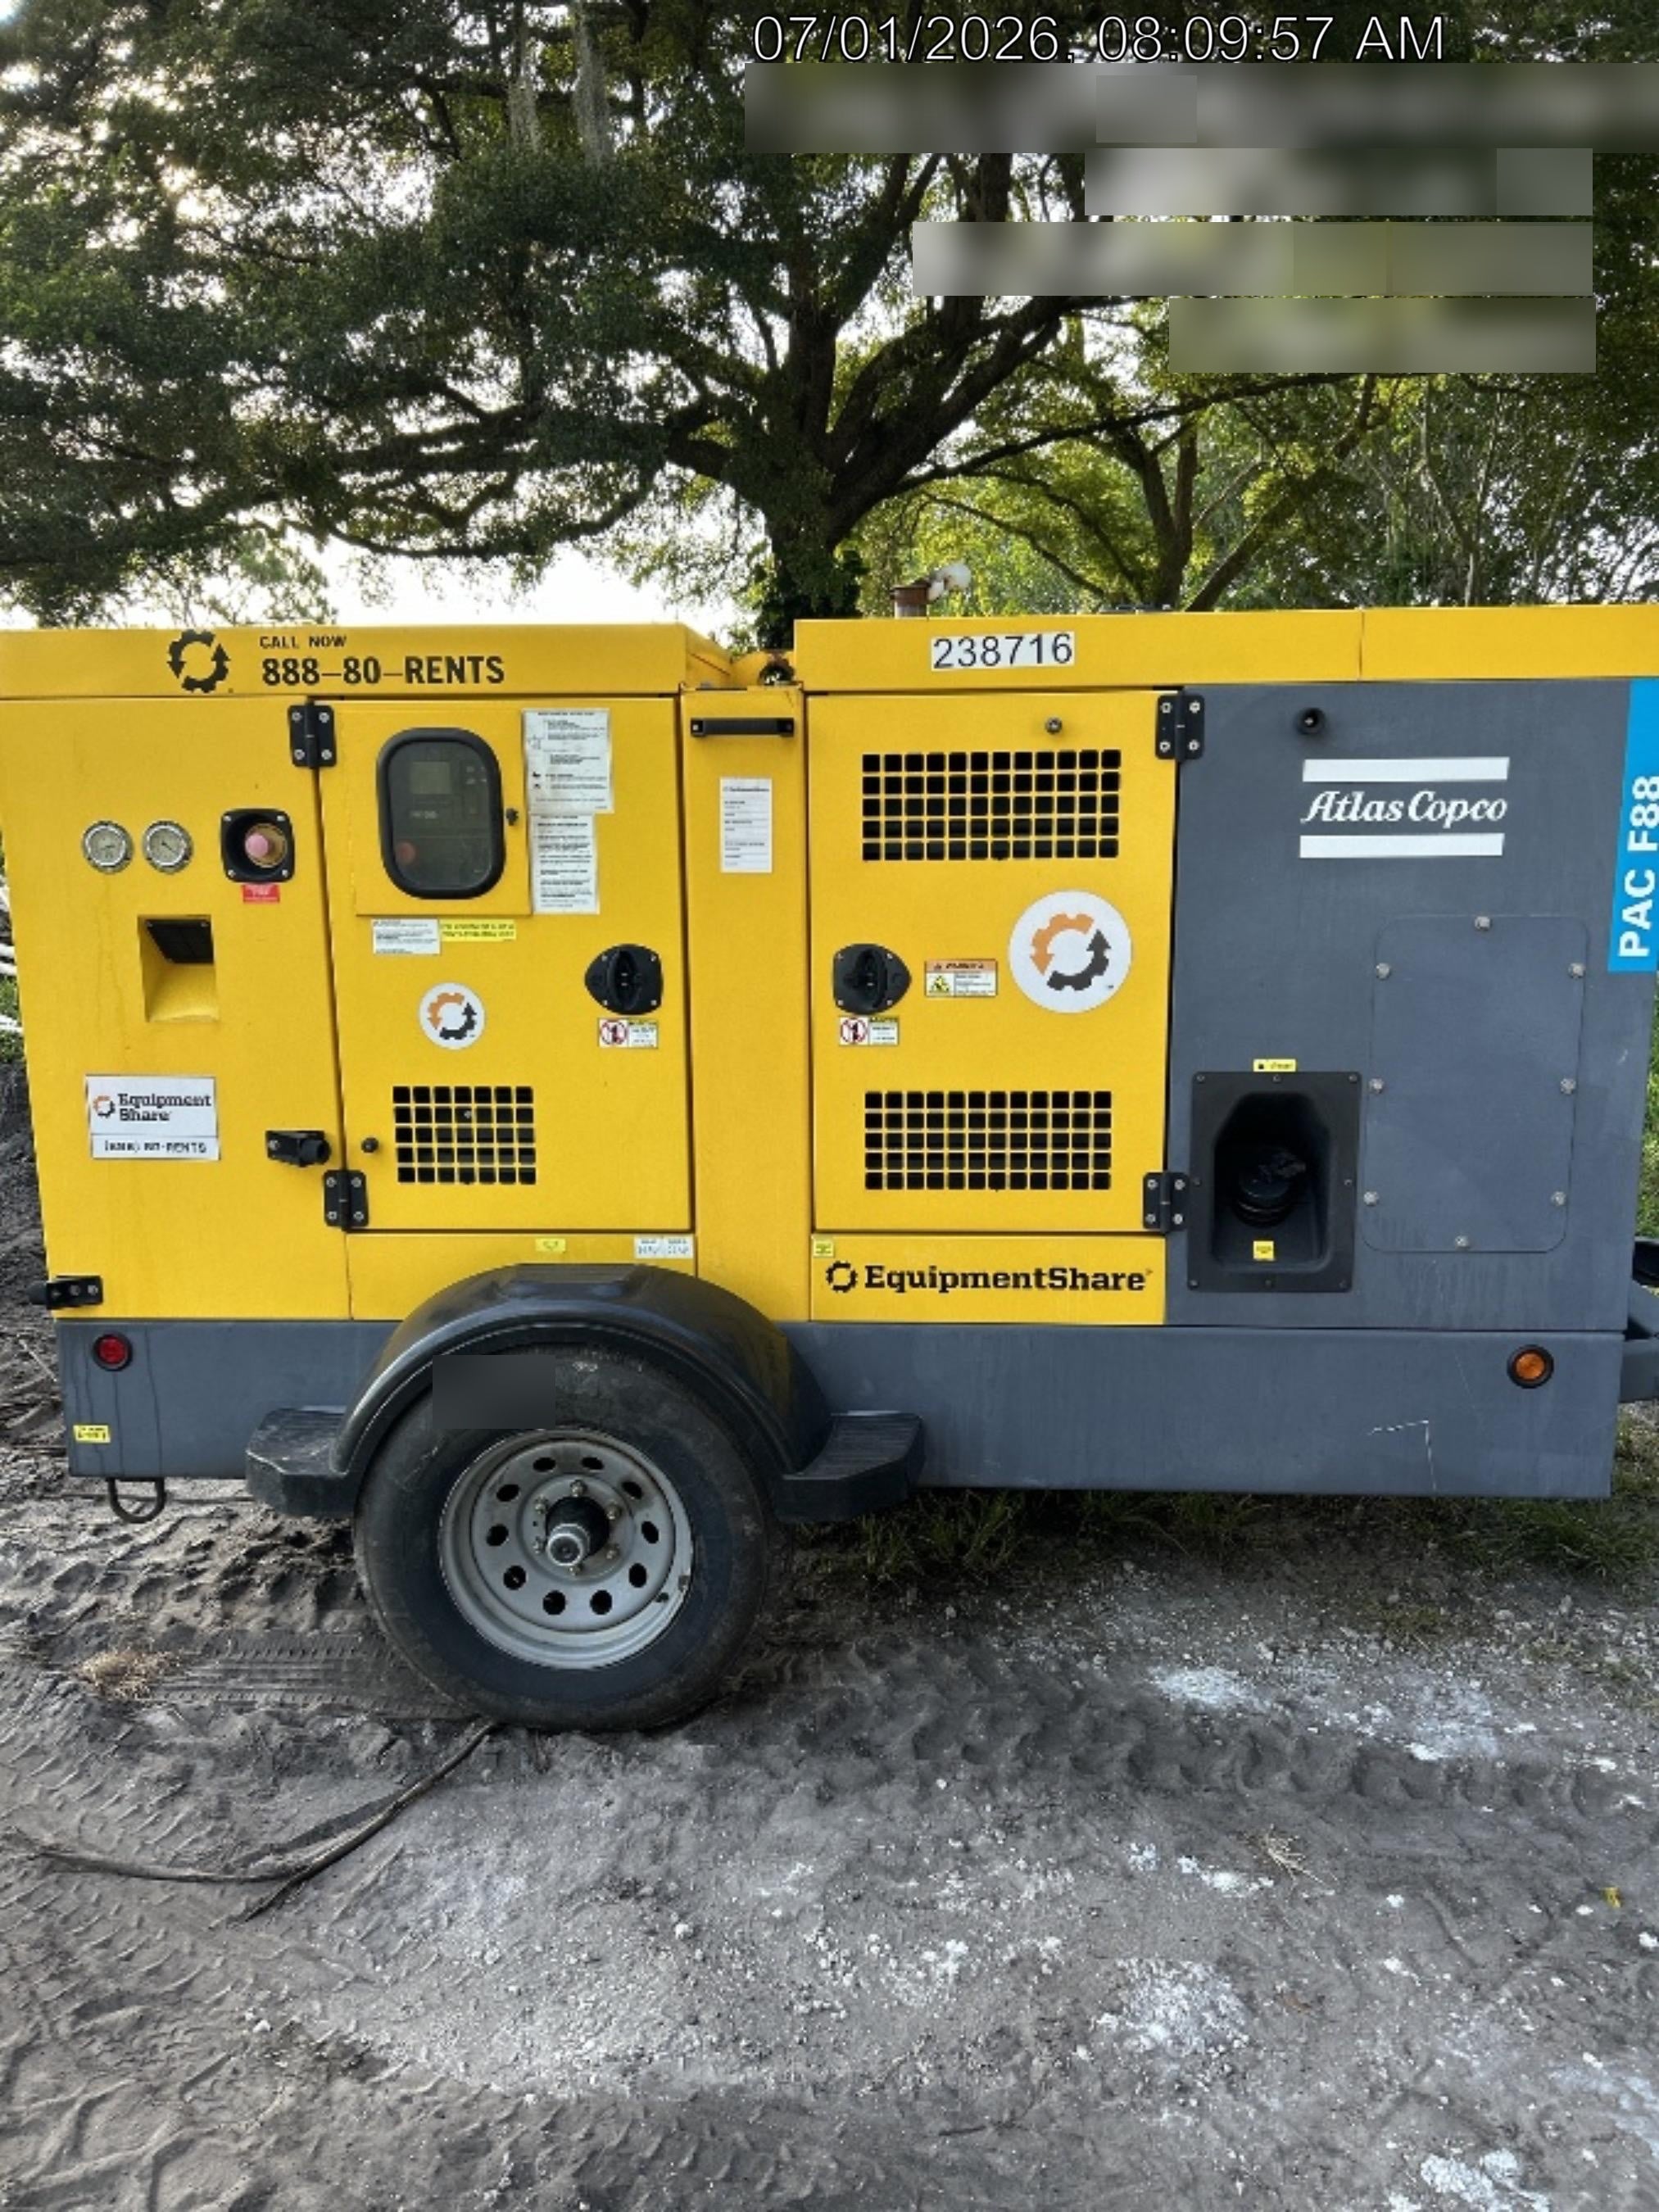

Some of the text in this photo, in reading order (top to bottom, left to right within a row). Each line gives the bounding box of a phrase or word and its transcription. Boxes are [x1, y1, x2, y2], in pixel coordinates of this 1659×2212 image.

[259, 636, 347, 650] CALL NOW
[933, 633, 1072, 669] 238716
[1299, 790, 1508, 829] Atlas Copco
[1617, 775, 1659, 957] PAC F88
[117, 1093, 211, 1109] Equipment
[864, 1264, 1147, 1294] EquipmentShare
